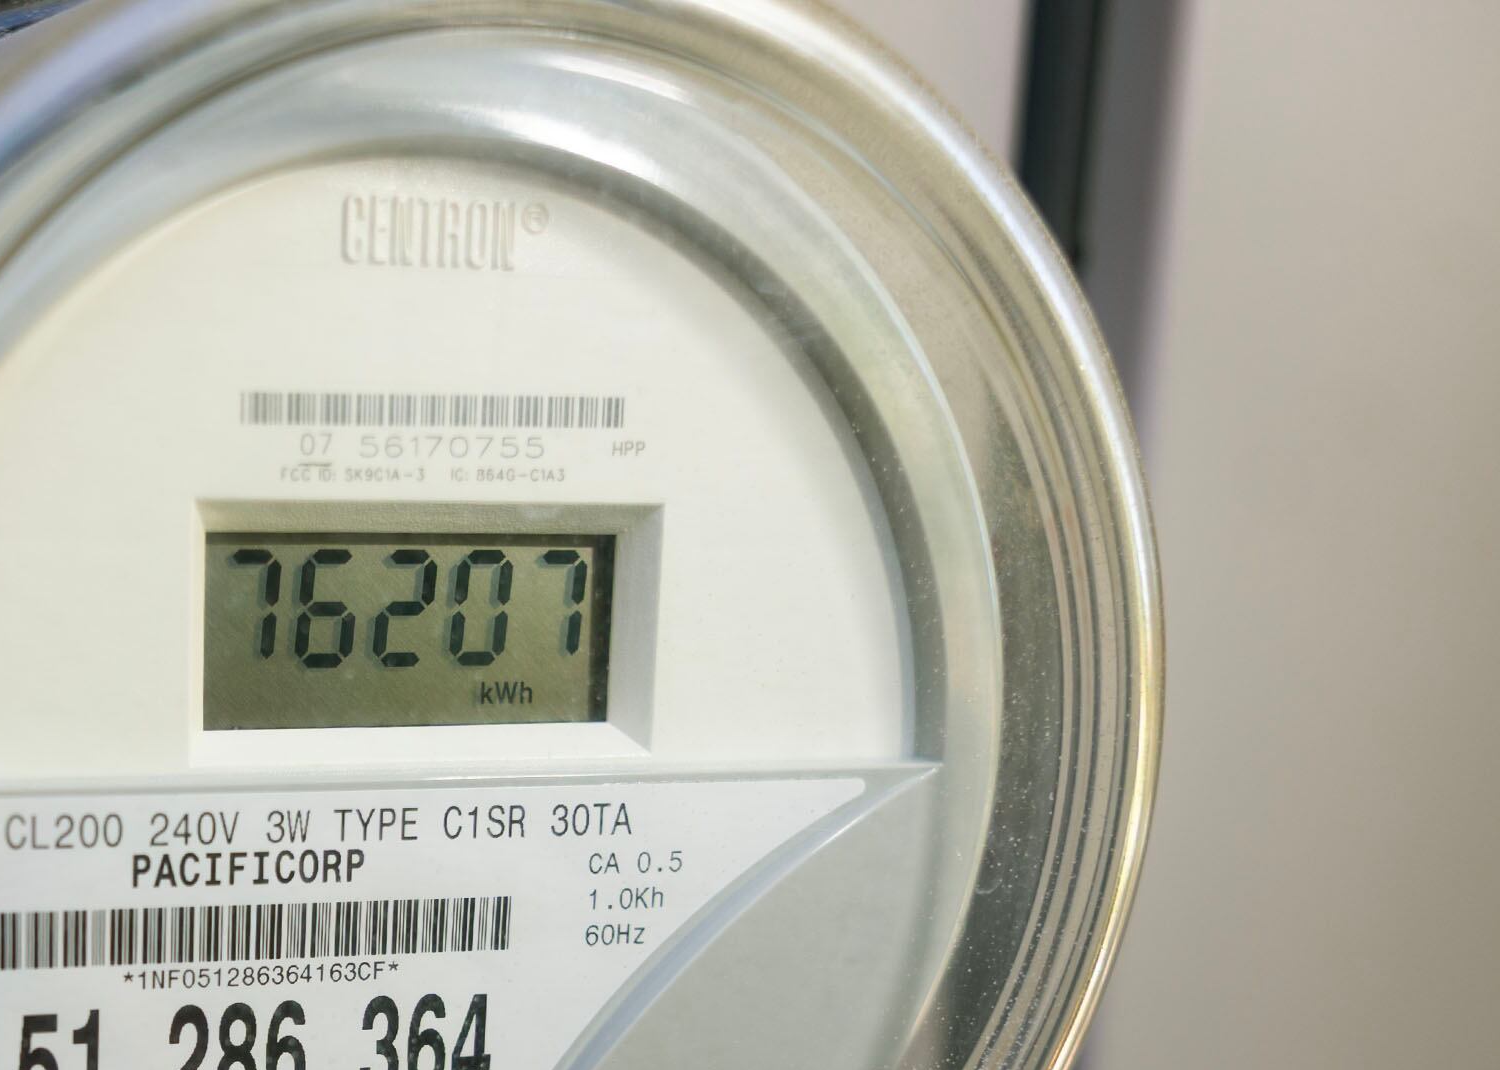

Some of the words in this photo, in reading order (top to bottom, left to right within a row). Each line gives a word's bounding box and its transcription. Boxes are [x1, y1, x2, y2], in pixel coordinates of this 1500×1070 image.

[299, 433, 333, 457] 07
[359, 434, 545, 459] 56170755
[611, 440, 646, 457] HPP
[280, 467, 311, 482] FCC
[232, 548, 588, 668] 76207
[479, 681, 534, 705] kWh
[5, 812, 124, 850] CL200
[149, 810, 240, 847] 240V
[266, 809, 311, 843] 3W
[334, 806, 419, 842] TYPE
[443, 805, 526, 839] C1SR
[550, 803, 632, 836] 30TA
[131, 849, 365, 888] PACIFICORP
[588, 852, 620, 875] CA
[637, 851, 683, 873] 0.5
[588, 887, 665, 911] 1.0Kh
[584, 923, 646, 947] 60Hz
